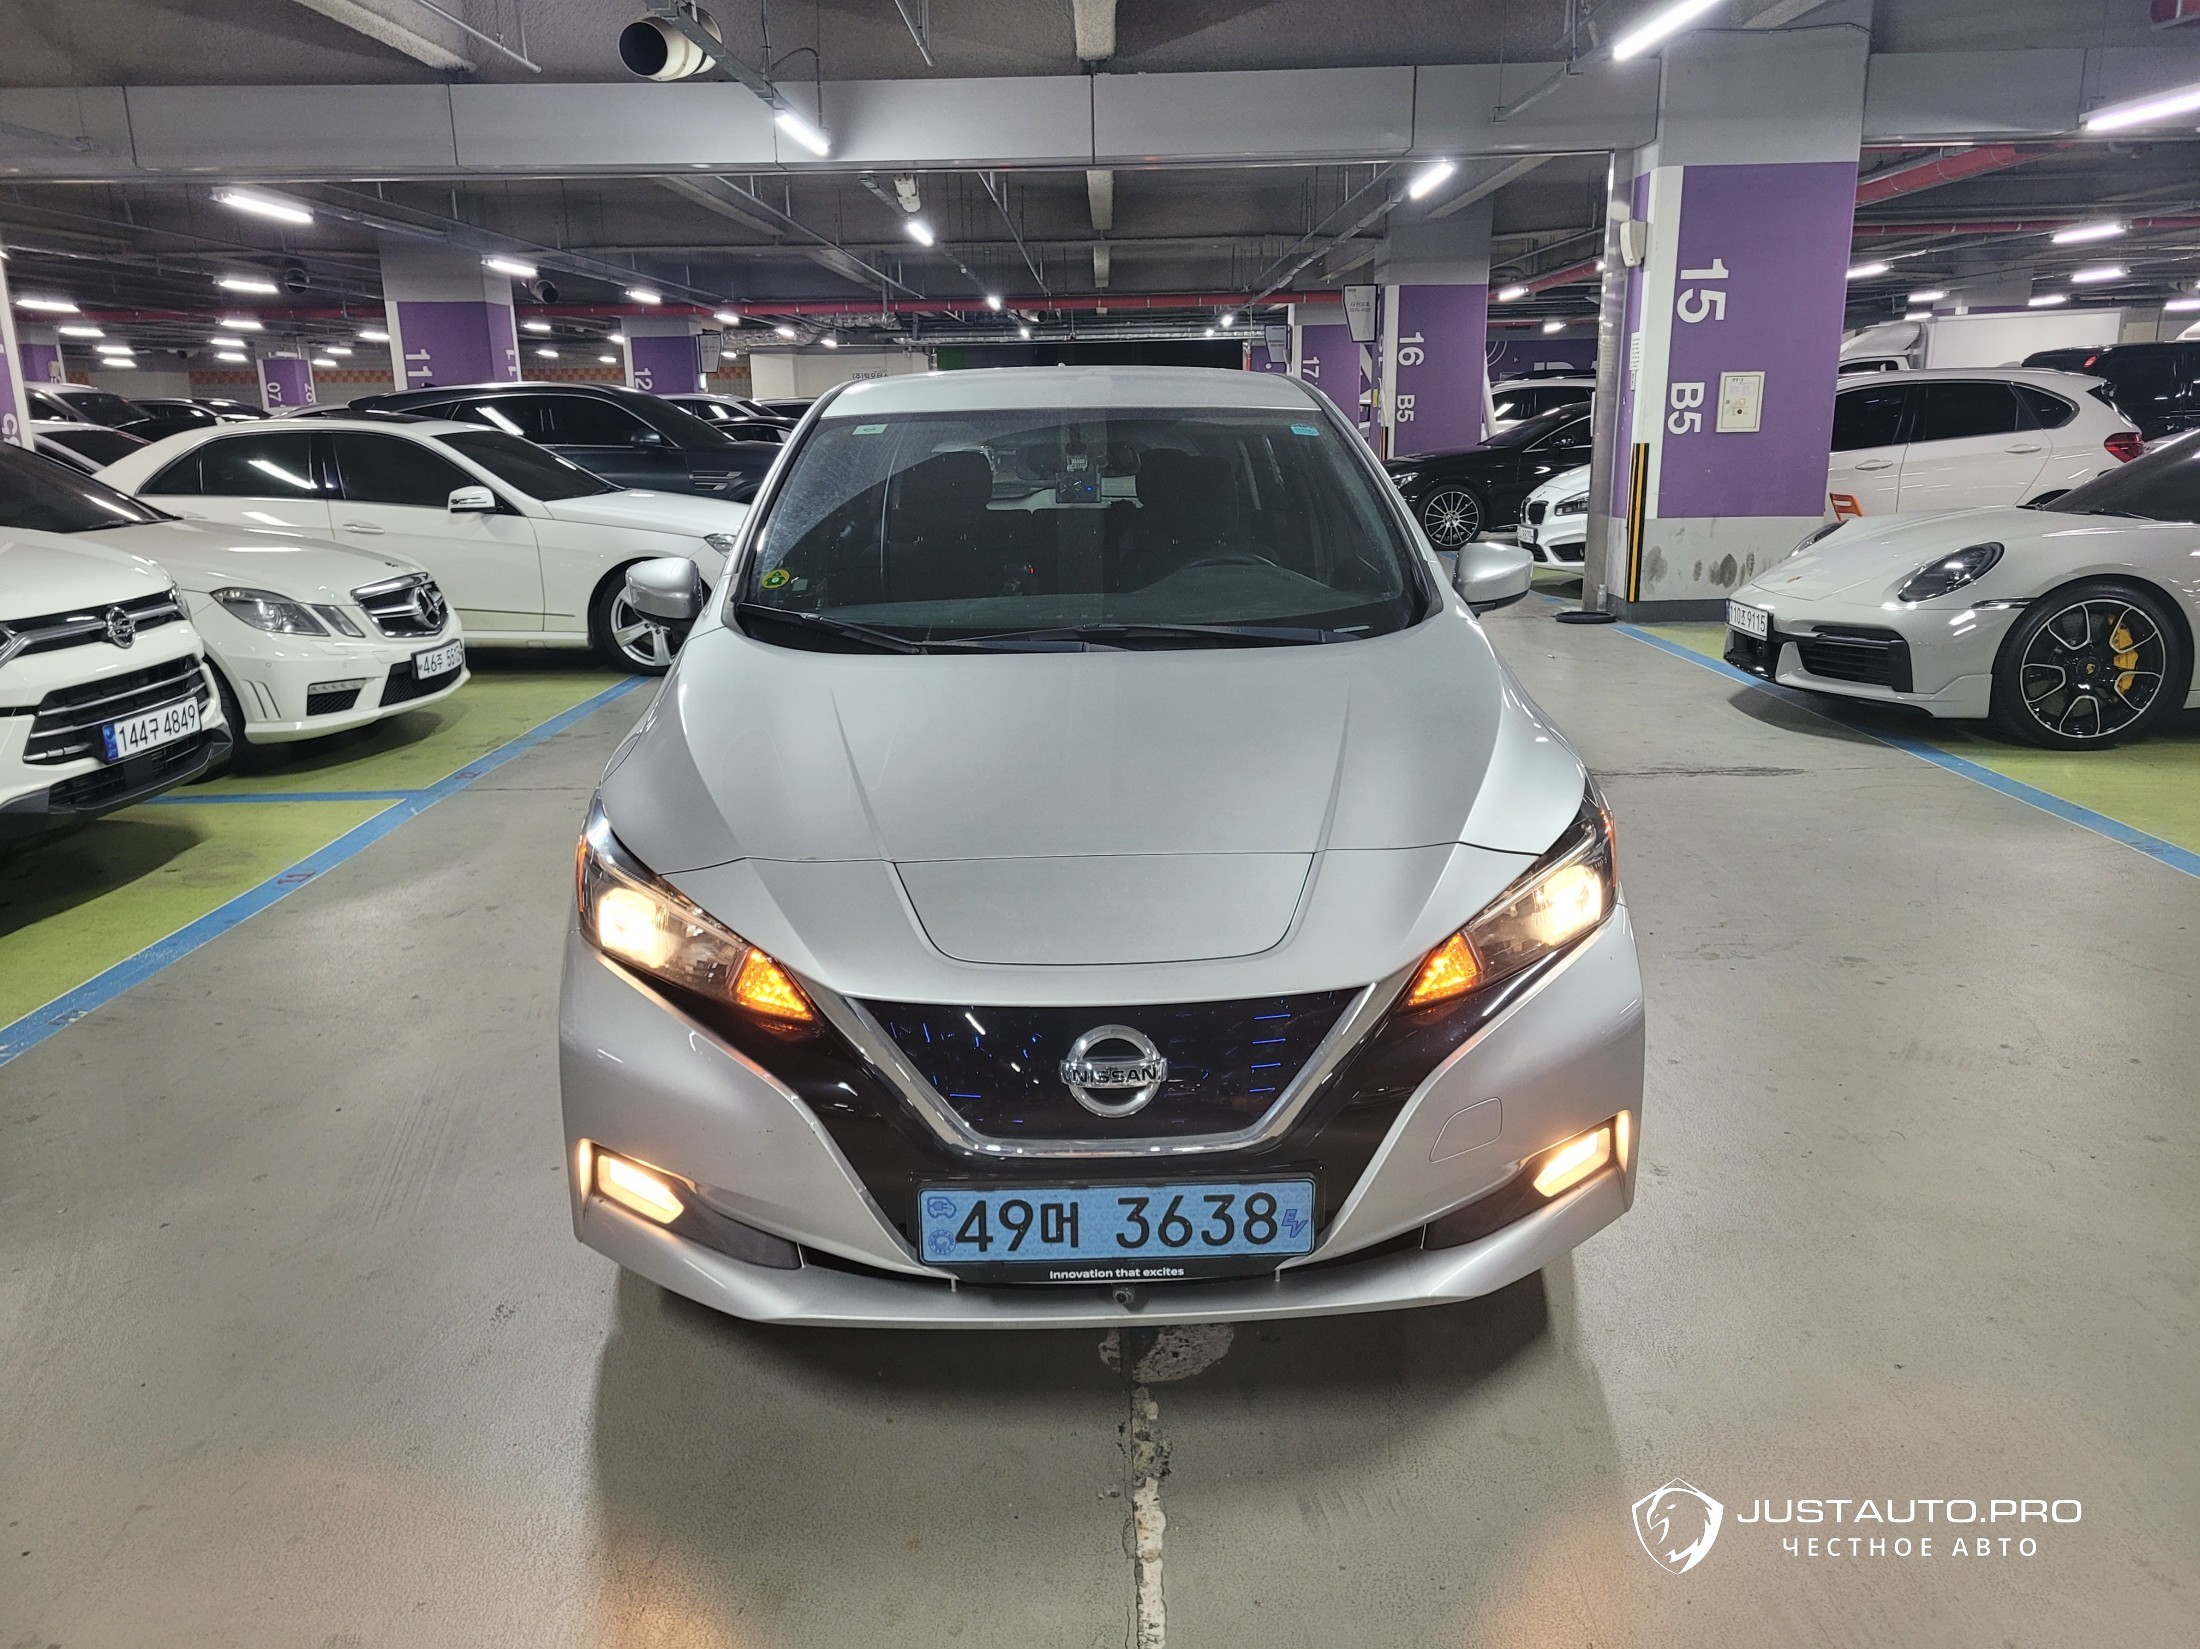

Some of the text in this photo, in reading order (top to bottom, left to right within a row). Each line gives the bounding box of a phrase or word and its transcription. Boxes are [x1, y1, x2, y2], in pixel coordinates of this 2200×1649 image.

[1676, 259, 1729, 323] 15
[405, 348, 433, 377] 11
[1398, 332, 1425, 366] 16
[634, 367, 654, 390] 12
[1303, 356, 1320, 378] 17
[267, 382, 282, 402] 07
[1396, 394, 1416, 423] B5
[1668, 382, 1705, 435] B5
[1747, 610, 1766, 633] 9115
[118, 717, 159, 752] 144구
[163, 704, 196, 736] 4849
[1072, 1067, 1157, 1083] NISSAN
[955, 1199, 1079, 1252] 49머
[1115, 1191, 1278, 1248] 3638
[1049, 1266, 1185, 1280] Innovation that excites
